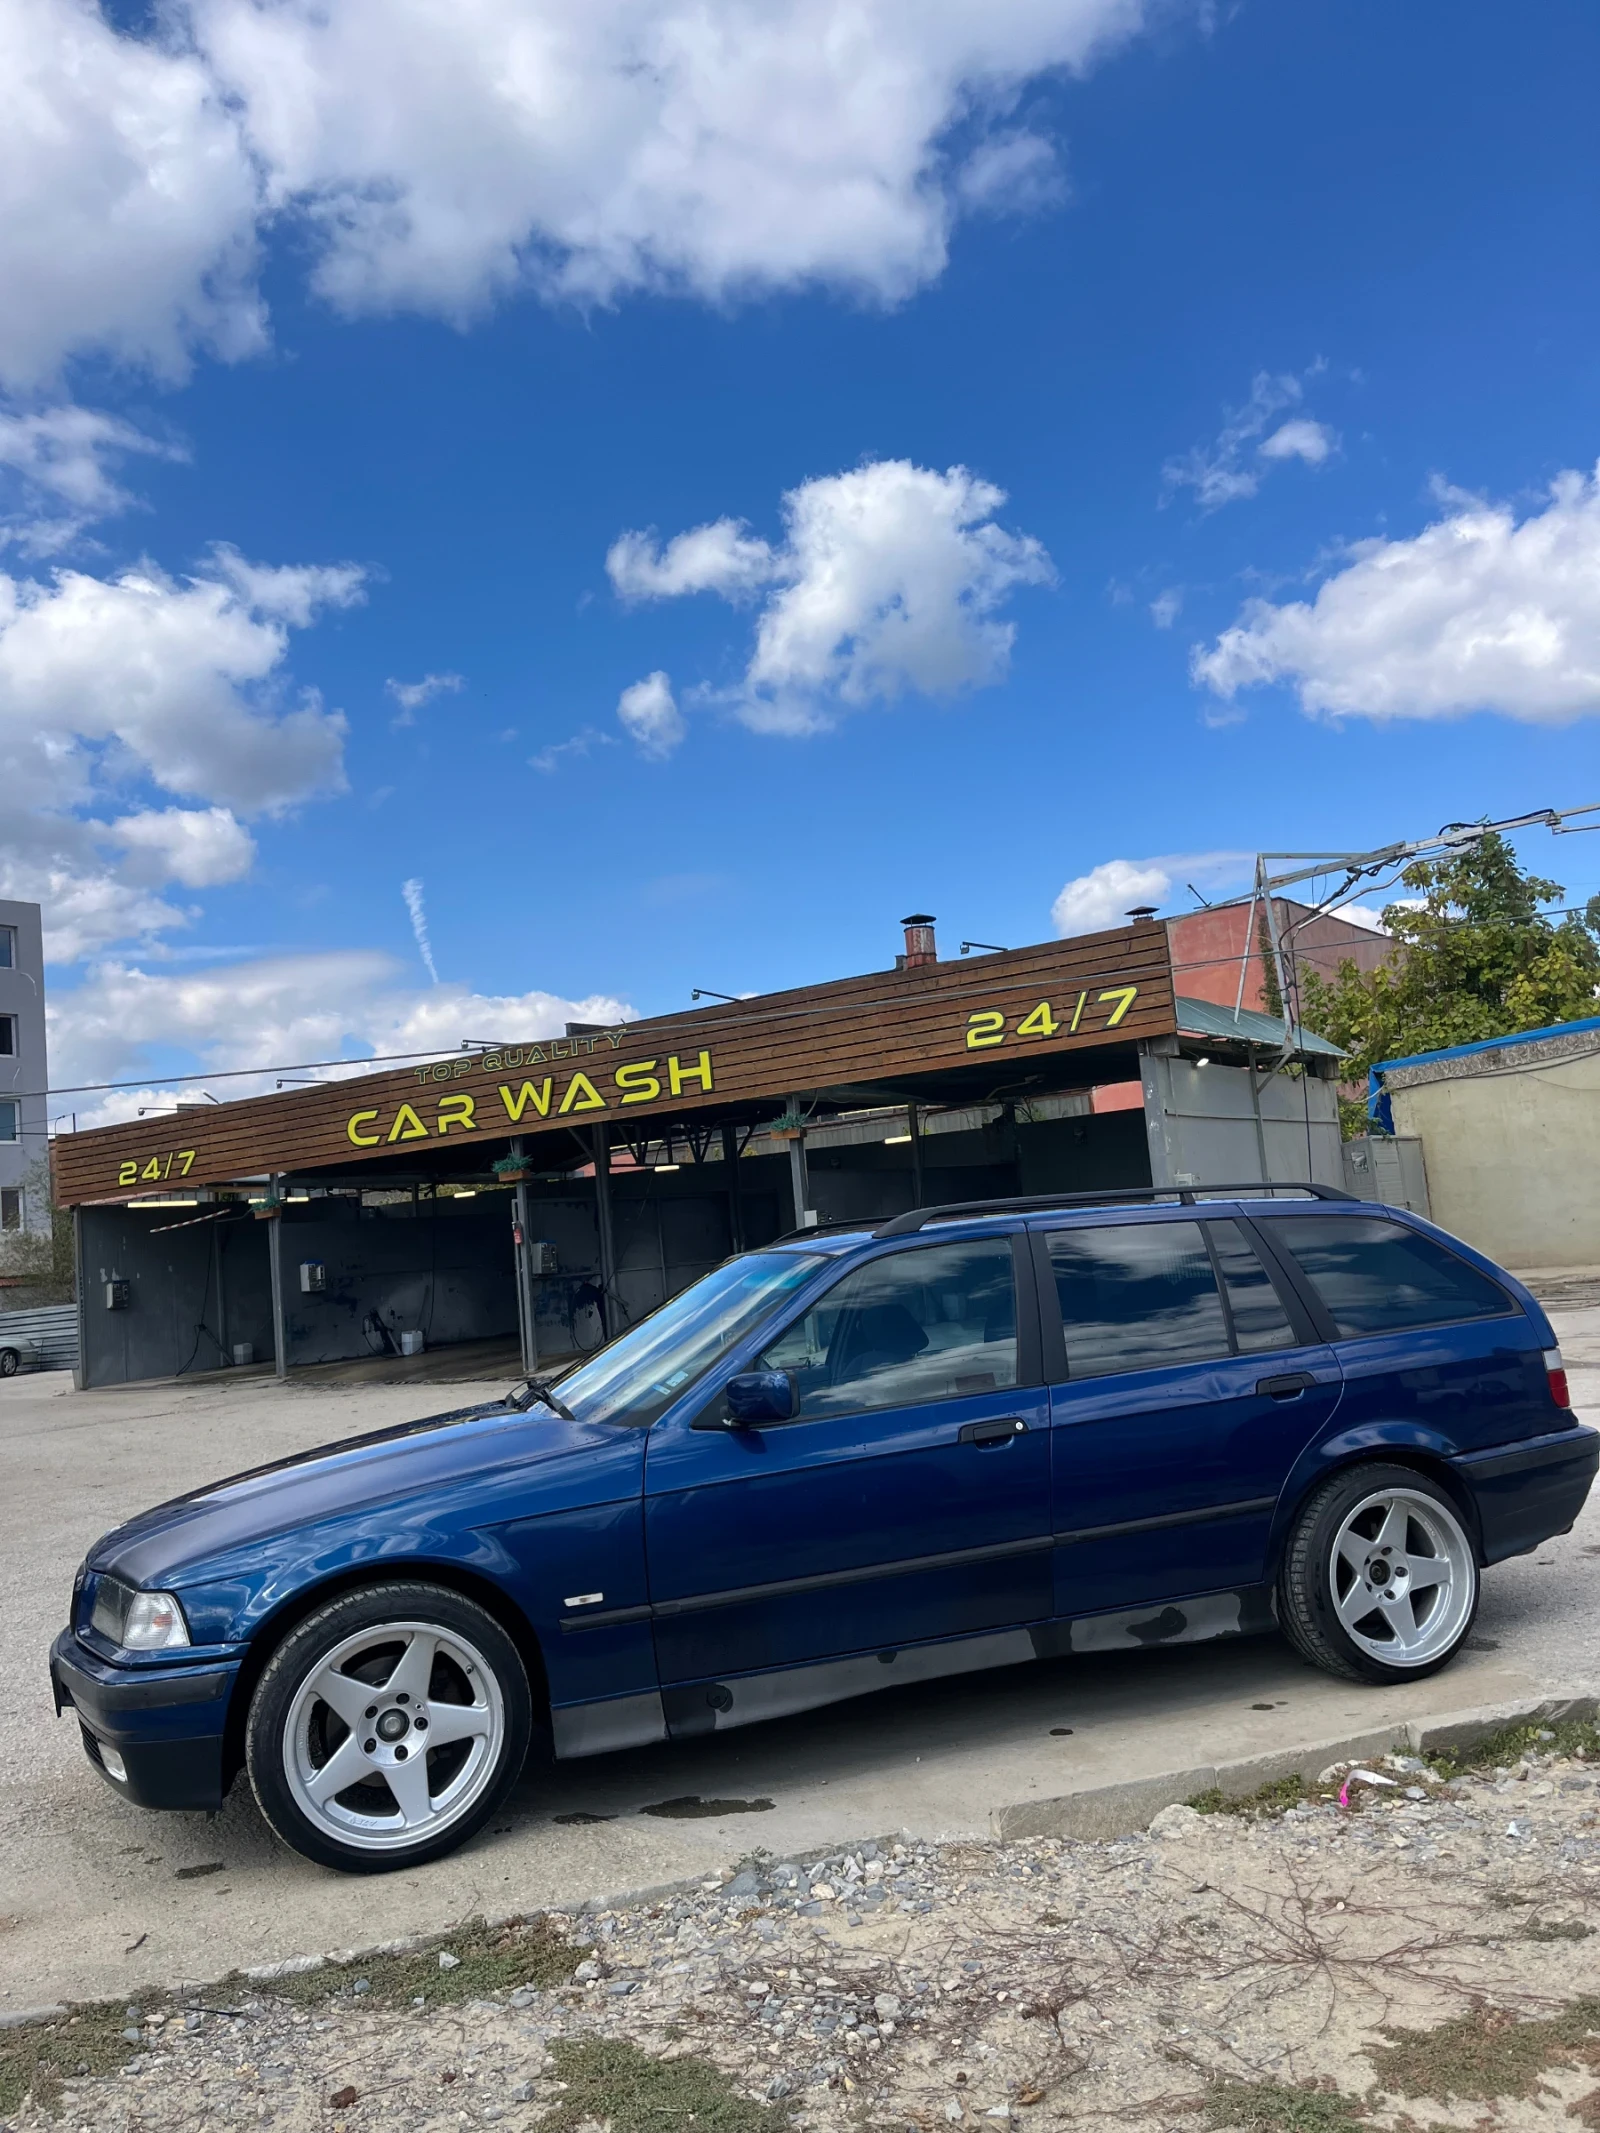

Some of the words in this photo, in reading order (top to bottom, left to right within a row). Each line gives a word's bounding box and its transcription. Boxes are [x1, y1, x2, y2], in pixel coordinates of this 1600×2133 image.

[966, 985, 1139, 1051] 24/7
[414, 1058, 472, 1084] TOP
[482, 1028, 627, 1072] QUALITY
[346, 1093, 478, 1147] CAR
[497, 1050, 714, 1123] WASH
[118, 1150, 196, 1186] 24/7
